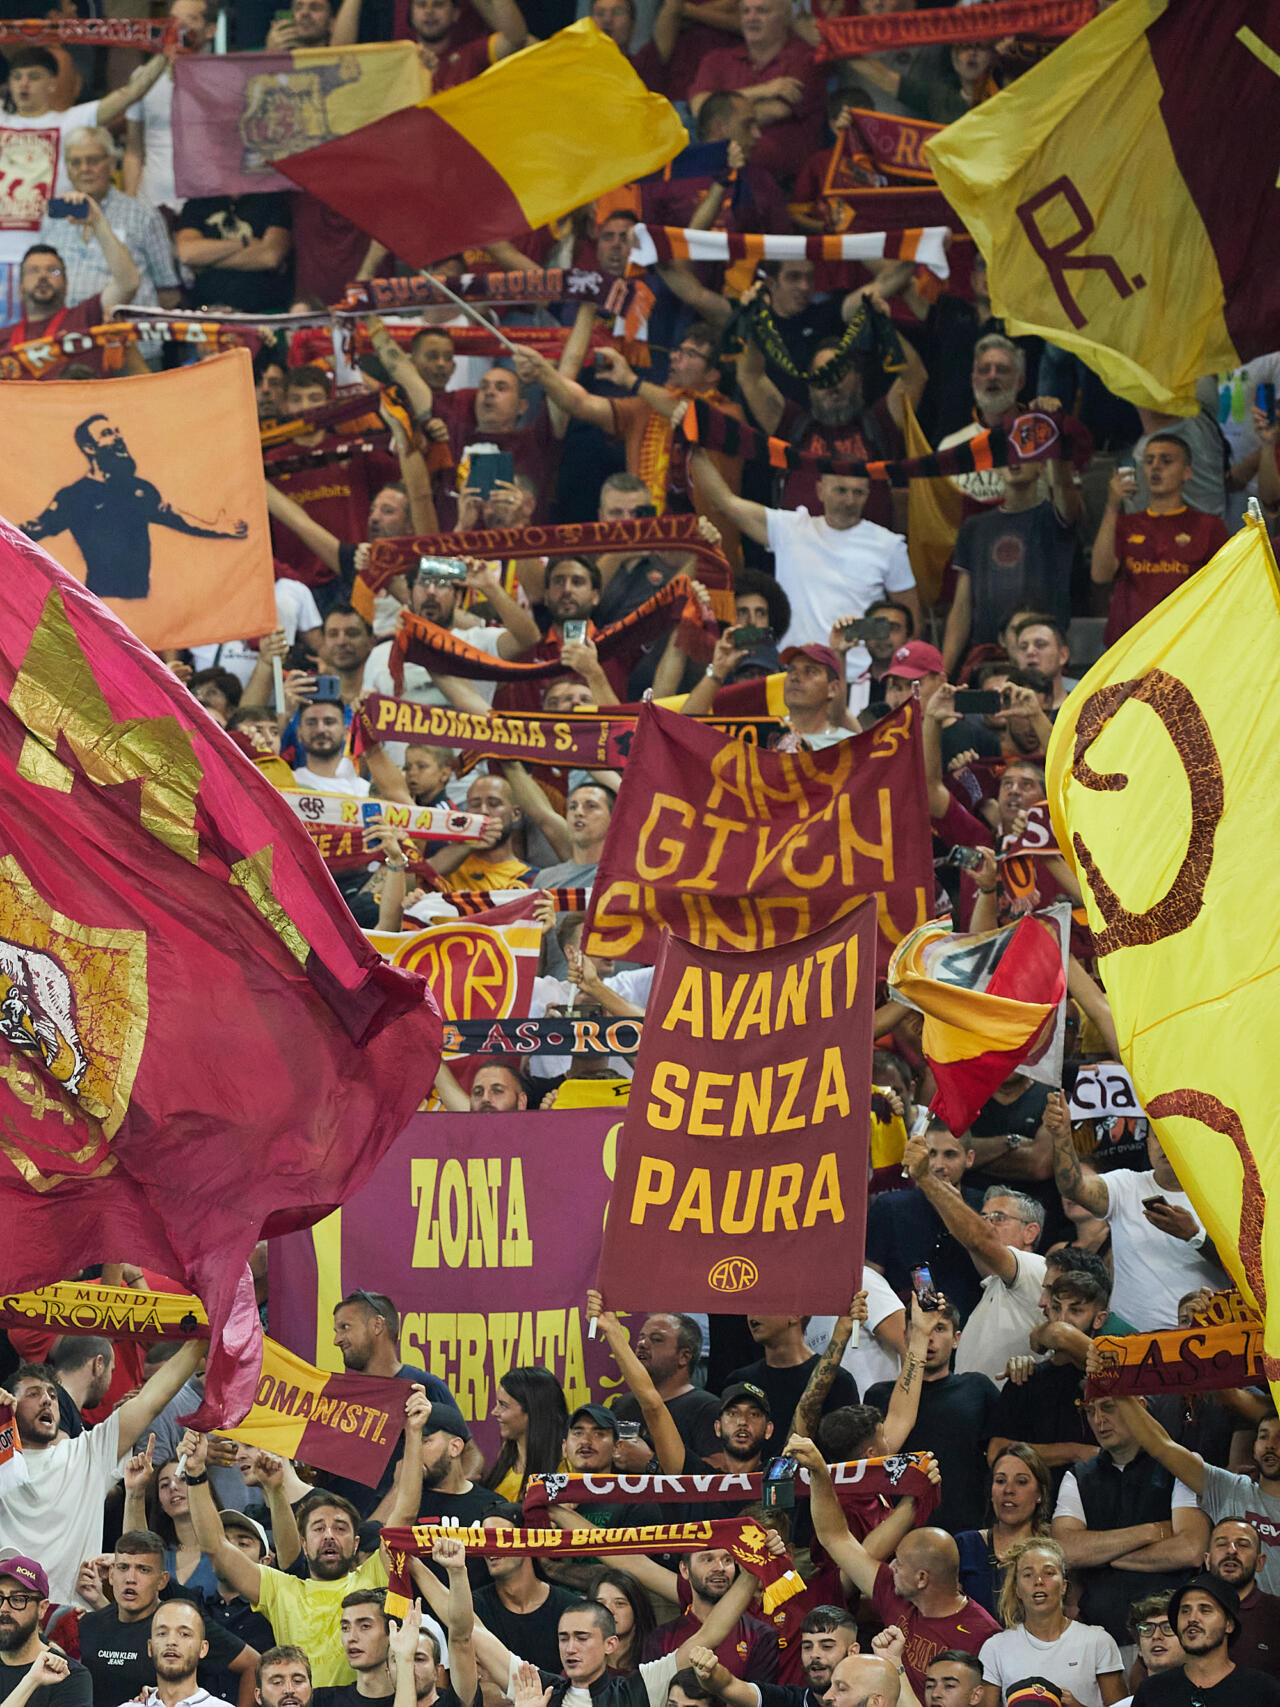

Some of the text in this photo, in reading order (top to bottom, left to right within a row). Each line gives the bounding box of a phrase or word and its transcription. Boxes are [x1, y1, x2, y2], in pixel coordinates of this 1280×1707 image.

[376, 699, 579, 752] PALOMBARA S.
[340, 801, 433, 832] RMA
[661, 933, 859, 1041] AVANTI
[477, 1021, 542, 1053] AS
[646, 1046, 851, 1138] SENZA
[629, 1153, 848, 1235] PAURA
[410, 1157, 533, 1269] ZONA
[74, 1290, 160, 1308] MUNDI
[42, 1300, 166, 1335] ROMA
[495, 1527, 563, 1549] CLUB
[570, 1519, 713, 1548] BRUXELLES
[15, 1565, 37, 1581] ROMA
[98, 1649, 138, 1660] CALVIN KLEIN
[107, 1658, 125, 1666] JEANS
